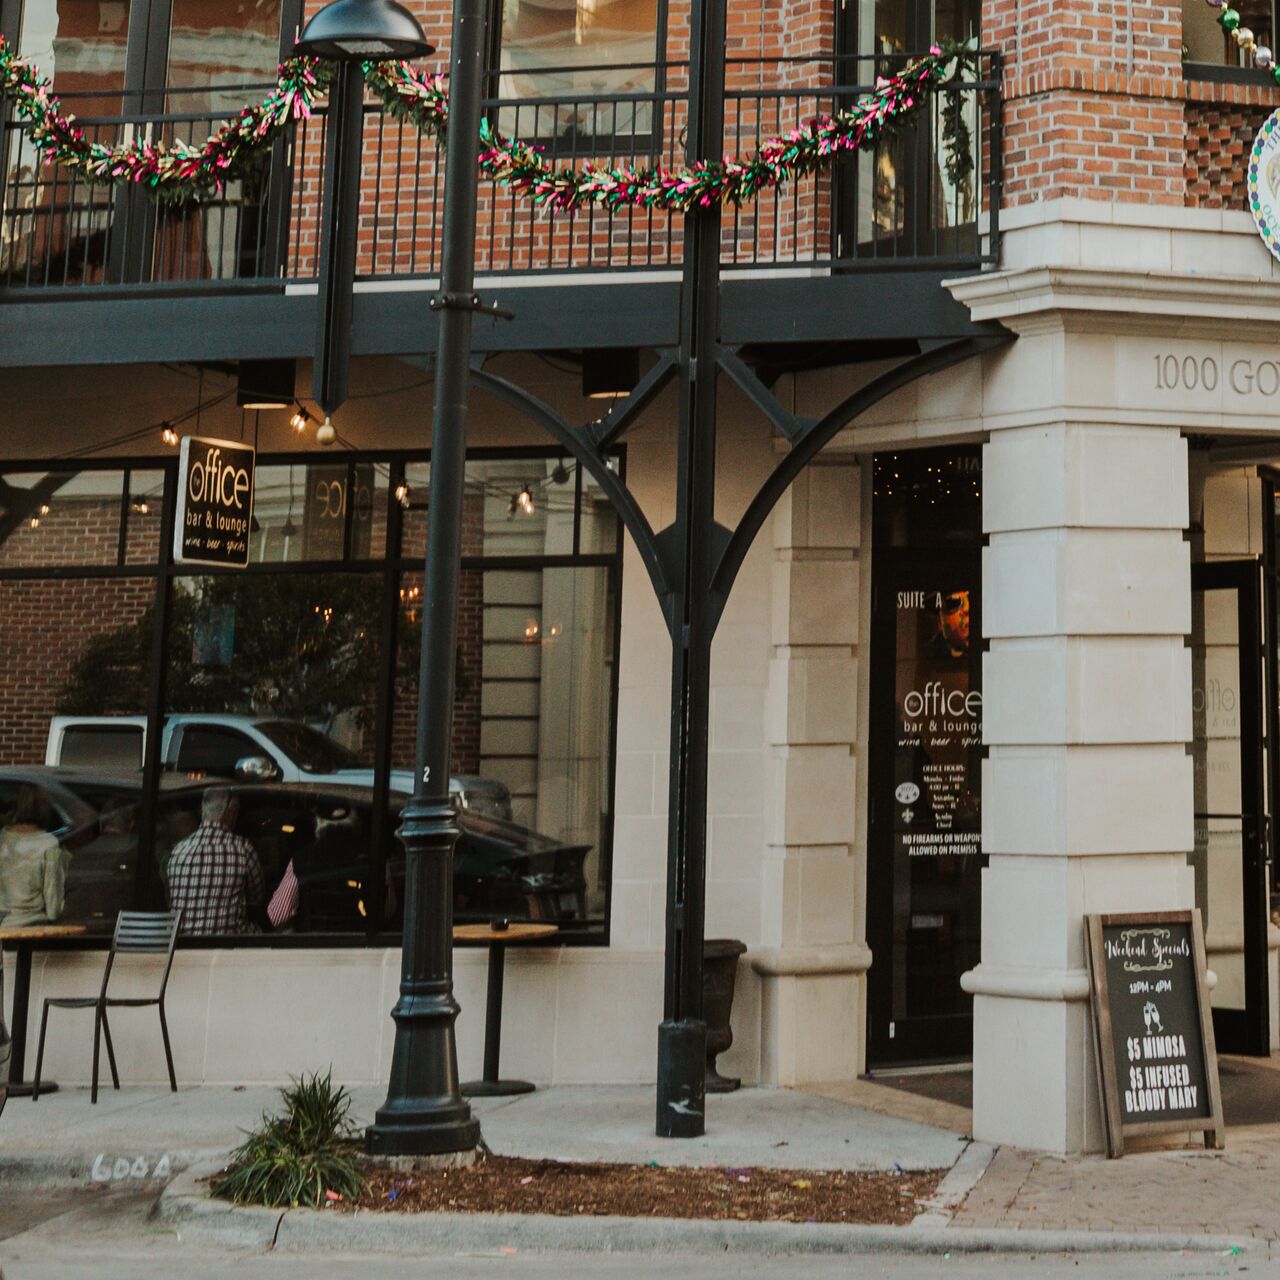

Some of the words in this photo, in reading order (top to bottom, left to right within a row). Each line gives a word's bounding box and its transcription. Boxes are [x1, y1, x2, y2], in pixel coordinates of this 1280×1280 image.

[1153, 354, 1219, 391] 1000
[189, 448, 249, 509] office
[186, 507, 202, 527] bar
[205, 510, 213, 529] &
[216, 511, 247, 537] lounge
[185, 537, 201, 548] wine
[206, 538, 221, 550] beer
[226, 539, 246, 556] spirits
[897, 591, 925, 609] SUITE
[935, 591, 942, 609] A
[904, 681, 982, 718] office
[904, 720, 923, 733] bar
[929, 719, 937, 732] &
[898, 738, 920, 747] wine
[930, 738, 950, 747] beer
[961, 737, 982, 749] spiri
[423, 766, 430, 783] 2
[902, 834, 912, 845] NO
[913, 834, 943, 844] FIREARMS
[944, 833, 953, 843] OR
[908, 845, 938, 856] ALLOWED
[938, 845, 948, 855] ON
[948, 844, 977, 855] PREMISIS
[1104, 937, 1147, 959] Weekend
[1151, 937, 1190, 964] Specials
[1129, 981, 1149, 994] 12PM
[1155, 979, 1172, 992] 4PM
[1127, 1036, 1141, 1062] $5
[1143, 1035, 1186, 1059] MIMOSA
[1129, 1065, 1143, 1090] $5
[1145, 1063, 1190, 1088] INFUSED
[1125, 1088, 1166, 1112] BLOODY
[1169, 1085, 1198, 1109] MARY
